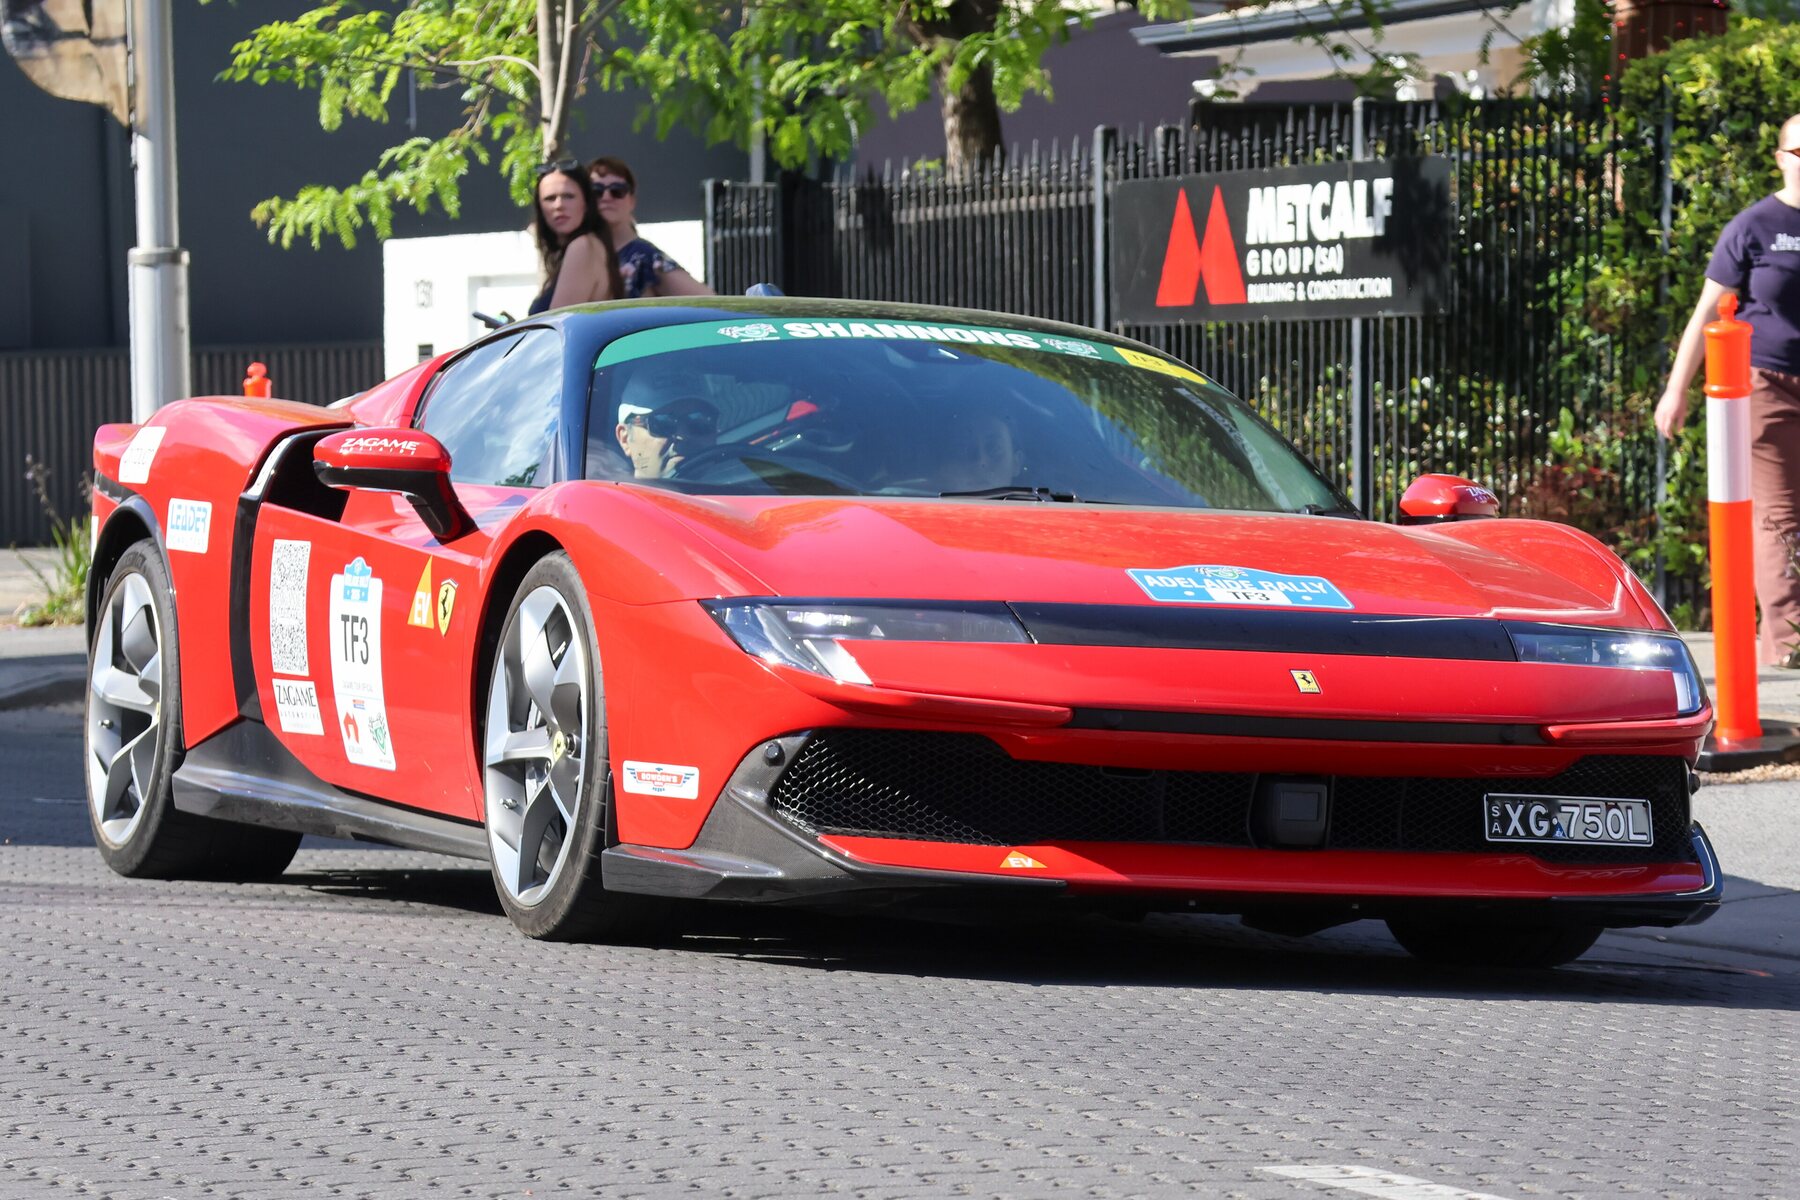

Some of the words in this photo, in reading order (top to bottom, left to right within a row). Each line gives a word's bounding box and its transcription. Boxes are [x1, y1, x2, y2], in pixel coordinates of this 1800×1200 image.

[1247, 282, 1295, 303] BUILDING
[1296, 281, 1306, 301] &
[1307, 277, 1392, 301] CONSTRUCTION
[783, 322, 1041, 349] SHANNONS
[341, 437, 420, 451] ZAGAME
[170, 503, 208, 534] LEADER
[1143, 575, 1254, 590] ADELAIDE
[1262, 581, 1328, 594] RALLY
[414, 590, 432, 625] EV
[1228, 592, 1270, 602] TF3
[341, 614, 369, 665] TF3
[276, 685, 316, 707] ZAGAME
[1008, 857, 1033, 868] EV
